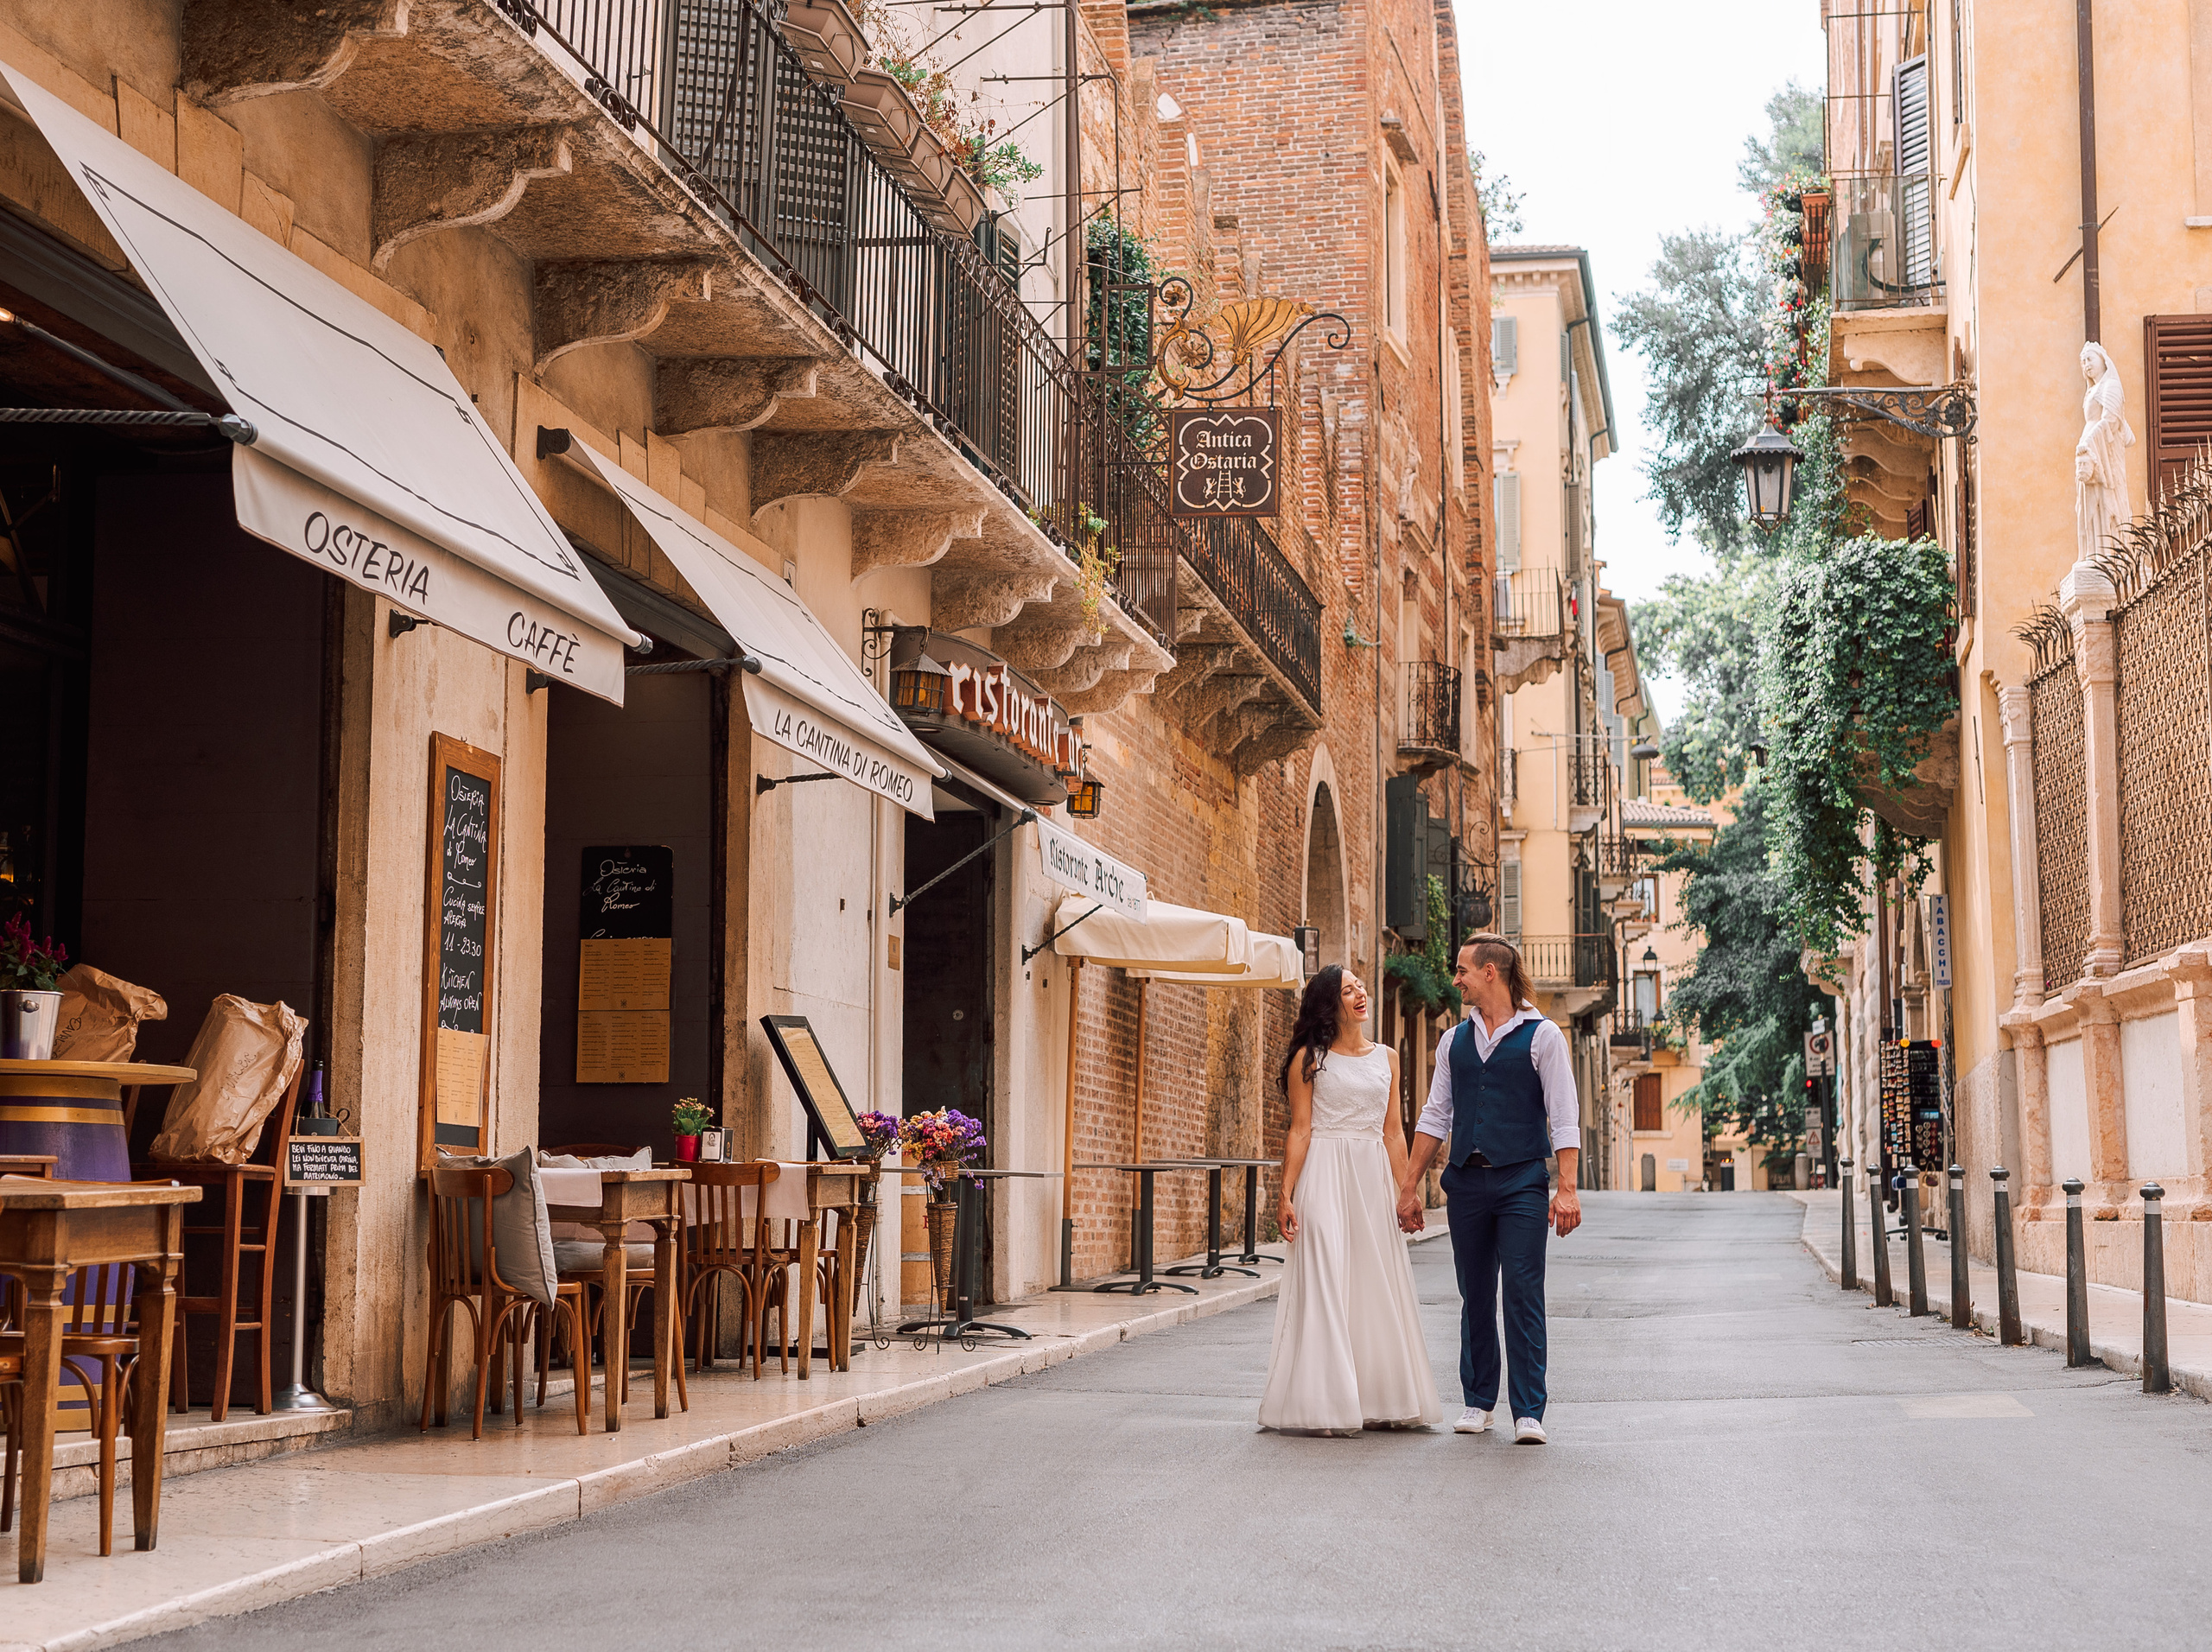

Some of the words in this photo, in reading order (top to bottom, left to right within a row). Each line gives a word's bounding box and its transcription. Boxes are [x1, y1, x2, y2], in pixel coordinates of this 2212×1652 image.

[1196, 430, 1252, 448] Antica
[1190, 452, 1257, 470] Ostaria
[304, 511, 429, 606] OSTERIA
[506, 611, 582, 673] CAFFÈ
[773, 708, 791, 741] LA
[796, 720, 851, 772] CANTINA
[853, 751, 869, 780] DI
[869, 759, 914, 803] ROMEO
[1049, 837, 1089, 886] Ristorante
[1094, 858, 1124, 904] Arche
[1936, 896, 1947, 978] TABACCHI
[463, 991, 483, 1012] OPEN
[302, 1153, 315, 1163] NON
[321, 1145, 327, 1153] A
[327, 1145, 352, 1153] QUANDO
